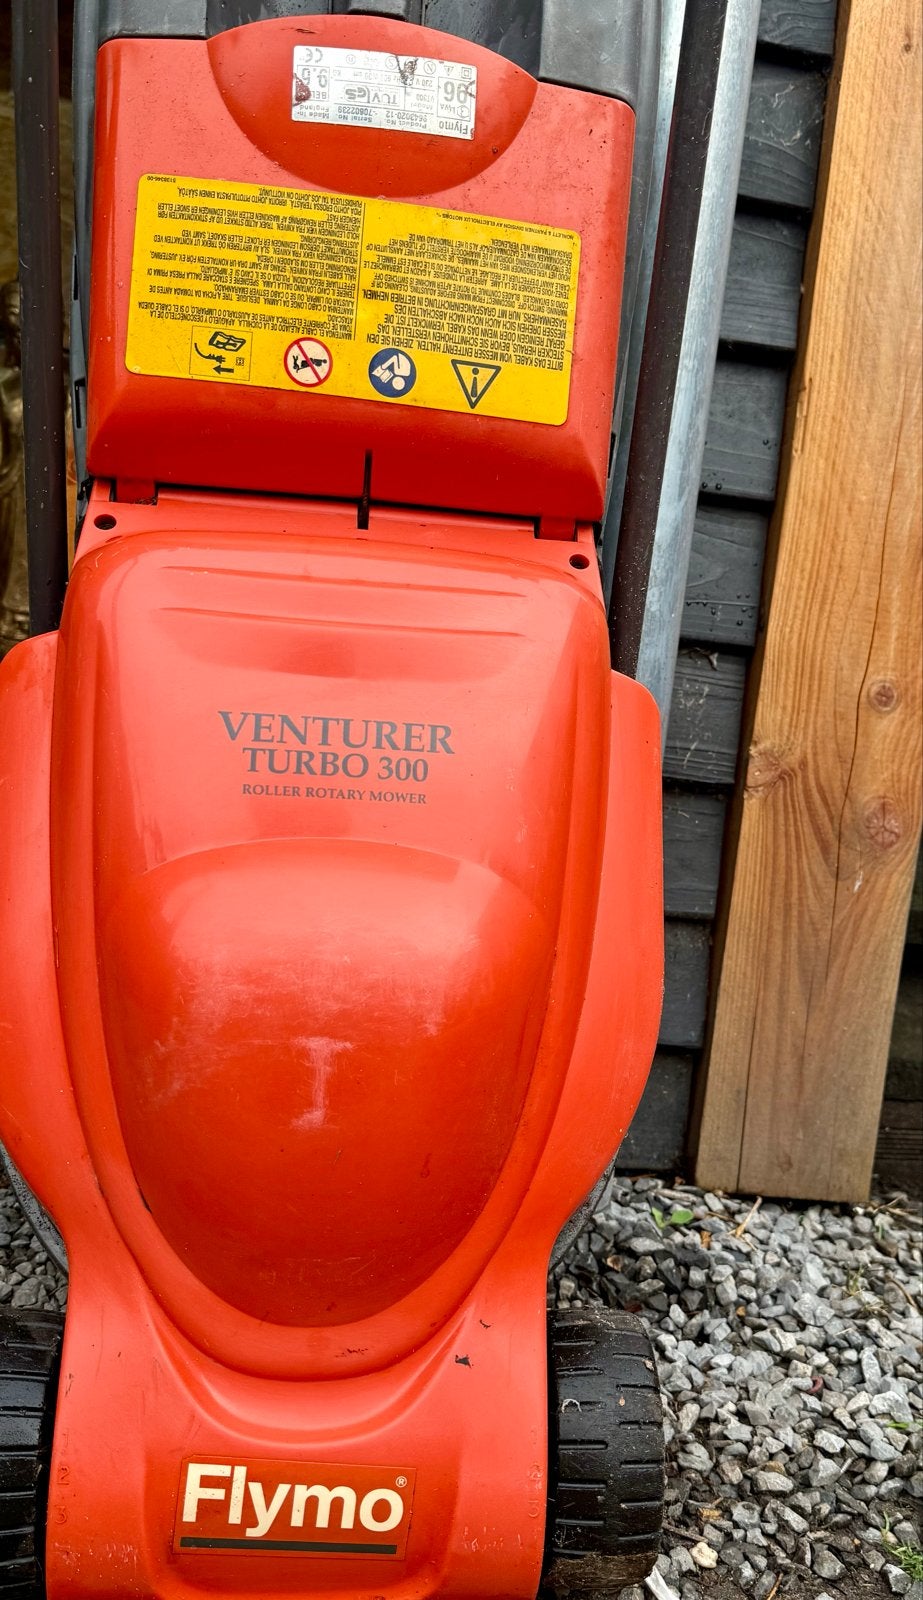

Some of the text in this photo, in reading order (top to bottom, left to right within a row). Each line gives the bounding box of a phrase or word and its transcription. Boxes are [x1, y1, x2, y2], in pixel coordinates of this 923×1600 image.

[443, 81, 468, 104] 96
[299, 103, 329, 113] England
[309, 111, 329, 119] Made
[351, 115, 372, 123] Serial
[399, 120, 427, 129] Product
[438, 119, 468, 135] Flymo
[390, 293, 415, 306] BETRIEB
[417, 297, 423, 307] IN
[384, 314, 394, 324] DIE
[497, 309, 507, 319] MIT
[507, 310, 521, 321] NUR
[394, 304, 566, 339] MESSER DREHEN SICH AUCH NOCH NACH ABSCHALTEN DES
[407, 317, 445, 331] VERWICKELT
[377, 324, 390, 334] DAS
[446, 323, 466, 335] KABEL
[467, 326, 479, 337] DAS
[481, 328, 498, 339] WENN
[366, 333, 379, 344] DEN
[381, 335, 390, 345] SIE
[499, 331, 516, 342] ODER
[517, 334, 544, 346] REINIGEN
[391, 337, 413, 349] ZIEHEN
[479, 339, 489, 349] SIE
[490, 340, 510, 352] BEVOR
[442, 344, 473, 357] ENTFERNT
[474, 349, 498, 361] MESSER
[537, 347, 564, 360] STECKER
[499, 352, 512, 363] VOM
[513, 354, 533, 366] KABEL
[534, 357, 546, 368] DAS
[547, 359, 563, 371] BITTE
[218, 711, 455, 754] VENTURER
[242, 747, 429, 782] TURBO 300
[242, 784, 427, 804] ROLLER ROTARY MOWER
[182, 1463, 404, 1538] Flymo
